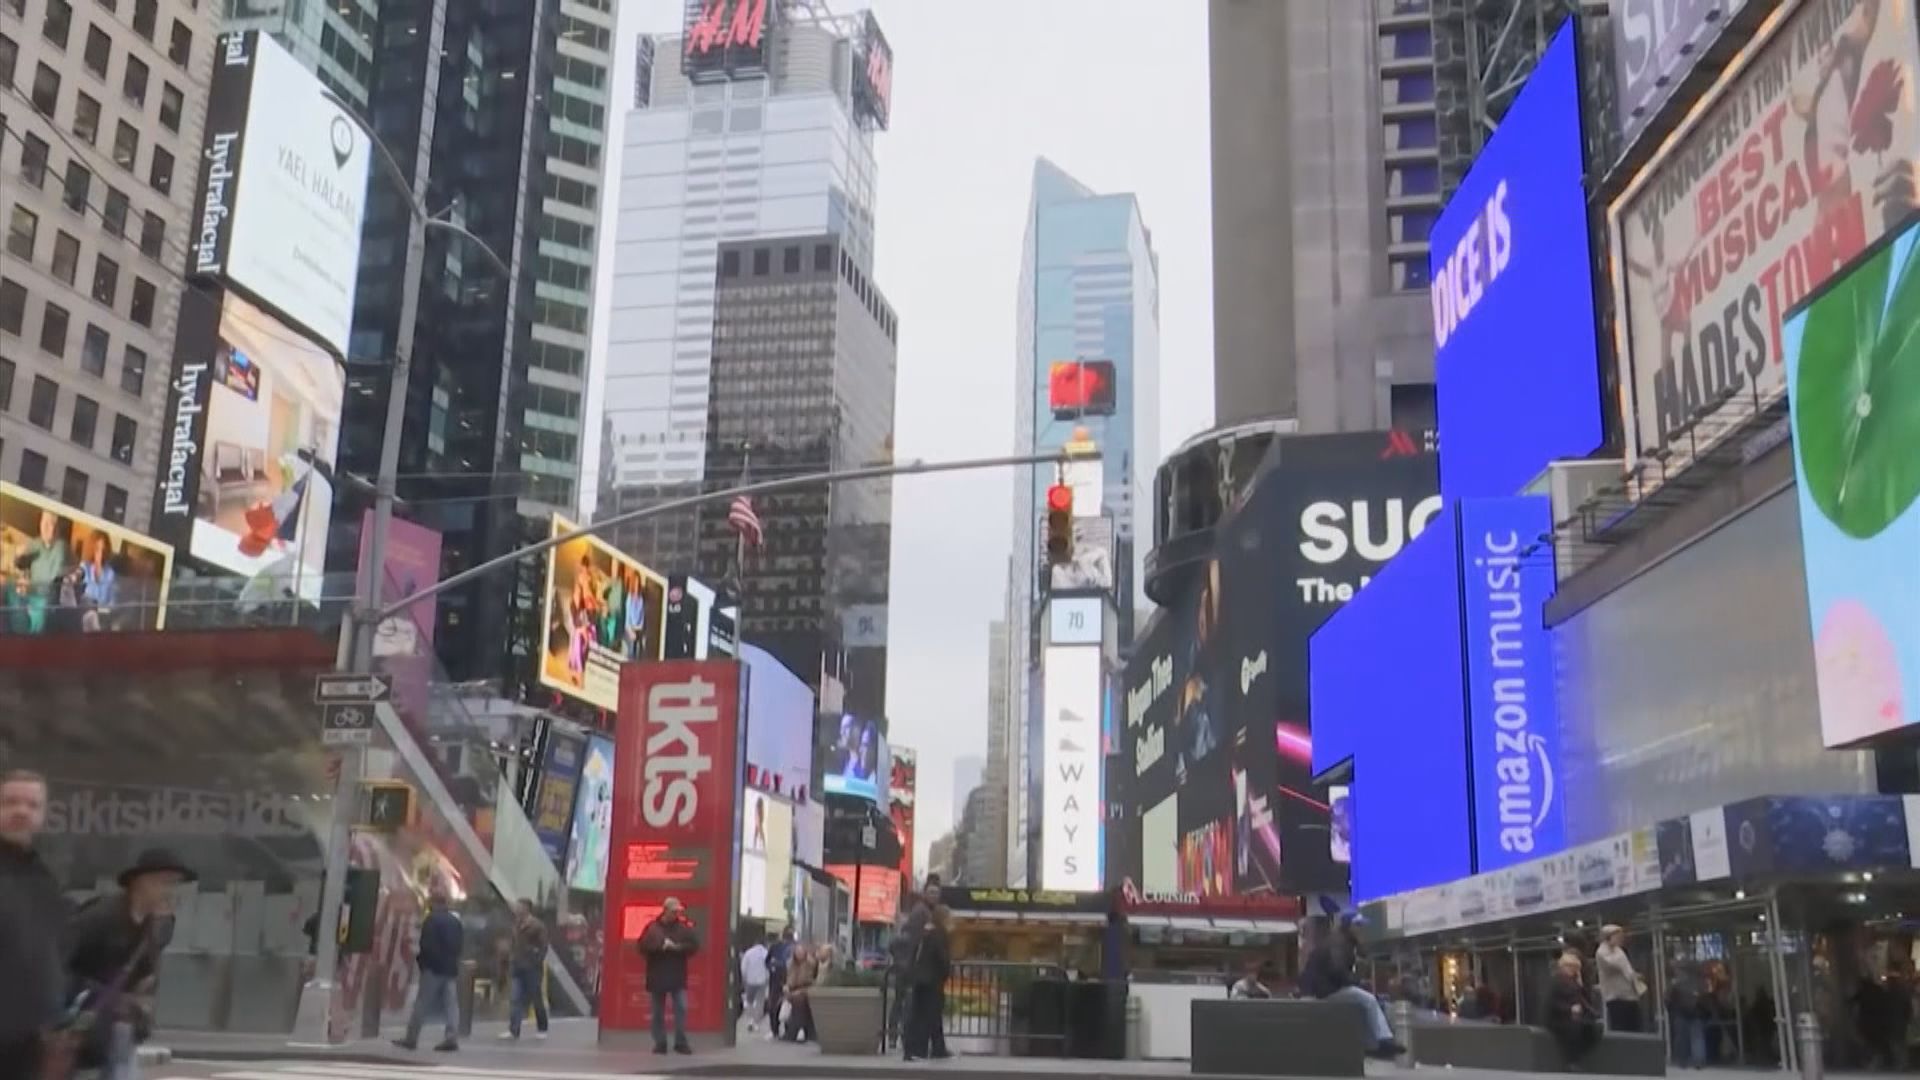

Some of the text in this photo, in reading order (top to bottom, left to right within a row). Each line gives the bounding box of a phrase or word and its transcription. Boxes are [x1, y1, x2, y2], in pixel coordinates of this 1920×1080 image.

[192, 131, 239, 274] hydrafacial
[277, 143, 307, 189] YAEL
[1670, 142, 1833, 322] MUSICAL
[1694, 102, 1787, 240] BEST
[1432, 179, 1511, 349] OICE IS
[160, 362, 207, 516] hydrafacial
[1068, 611, 1084, 630] 70
[1297, 578, 1354, 603] The
[642, 675, 719, 828] tkts
[1476, 530, 1535, 854] amazon music
